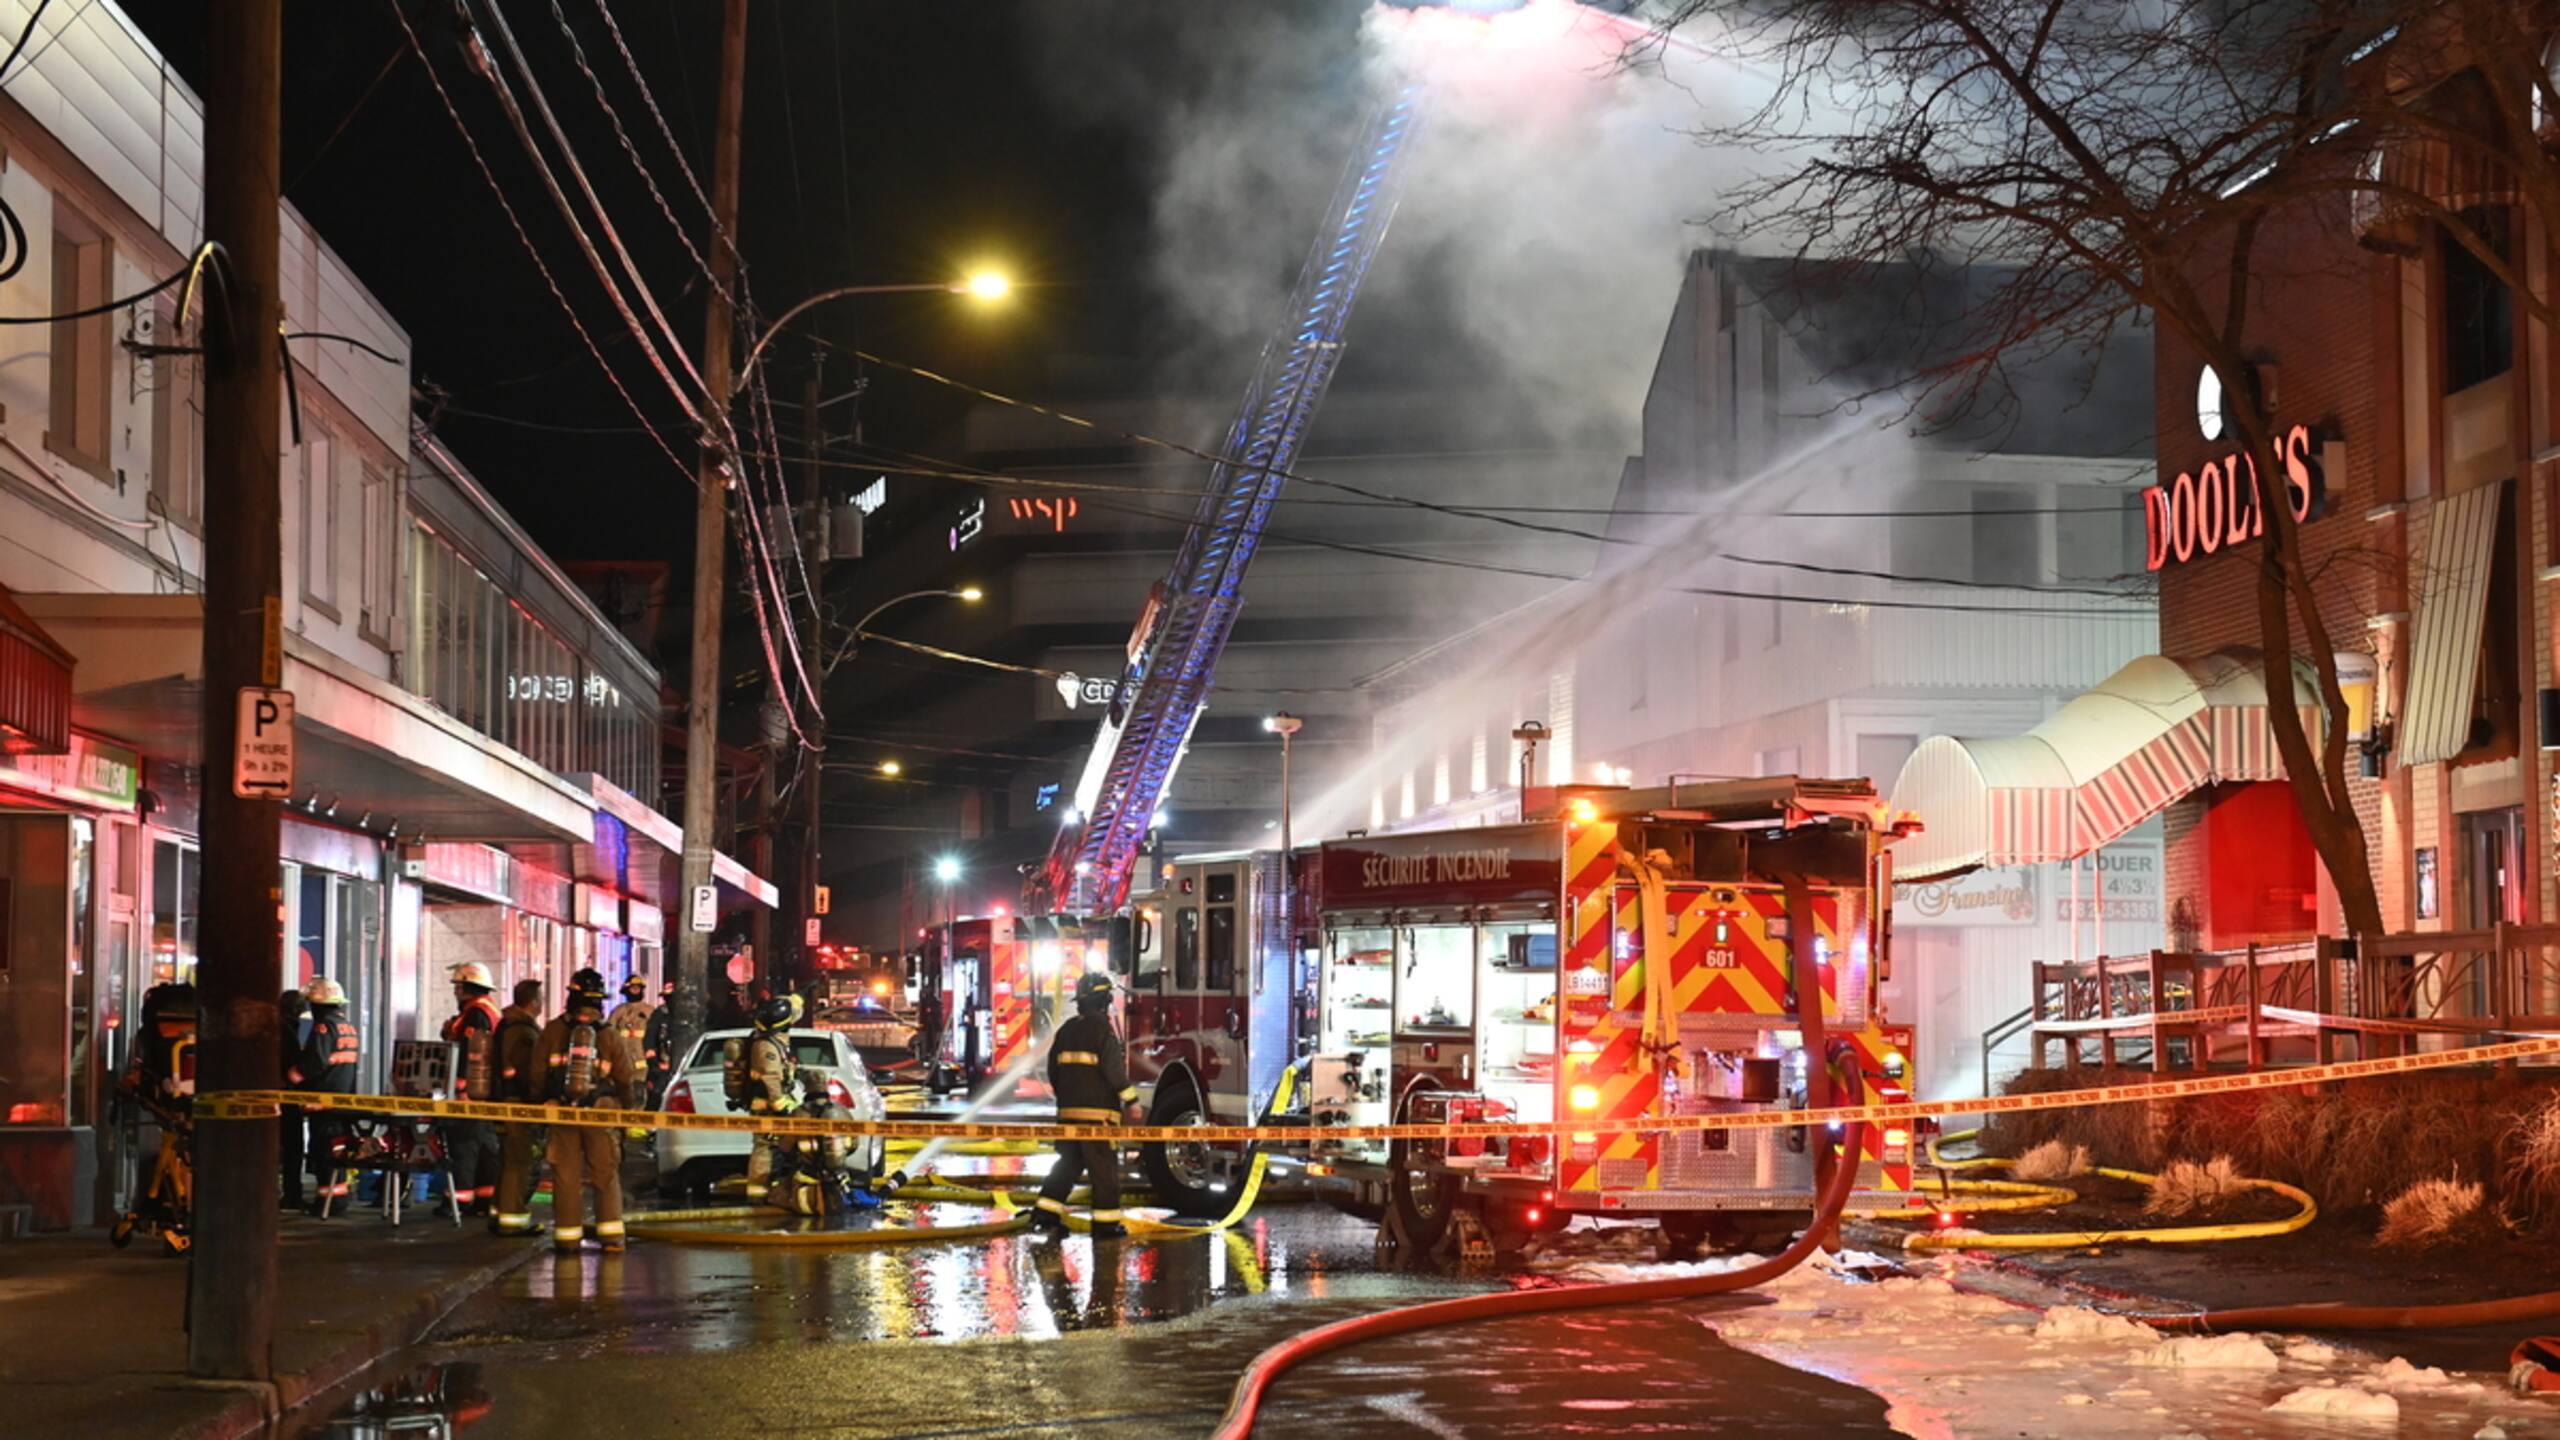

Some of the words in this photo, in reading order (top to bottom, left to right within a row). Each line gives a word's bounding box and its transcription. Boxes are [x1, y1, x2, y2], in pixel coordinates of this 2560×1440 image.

[1009, 498, 1077, 532] wsp
[255, 699, 278, 737] P
[254, 744, 289, 755] HEURE
[1363, 846, 1431, 887] SÉCURITÉ
[1437, 848, 1511, 882] INCENDIE
[2082, 856, 2153, 871] LOUER
[1706, 950, 1735, 967] 601
